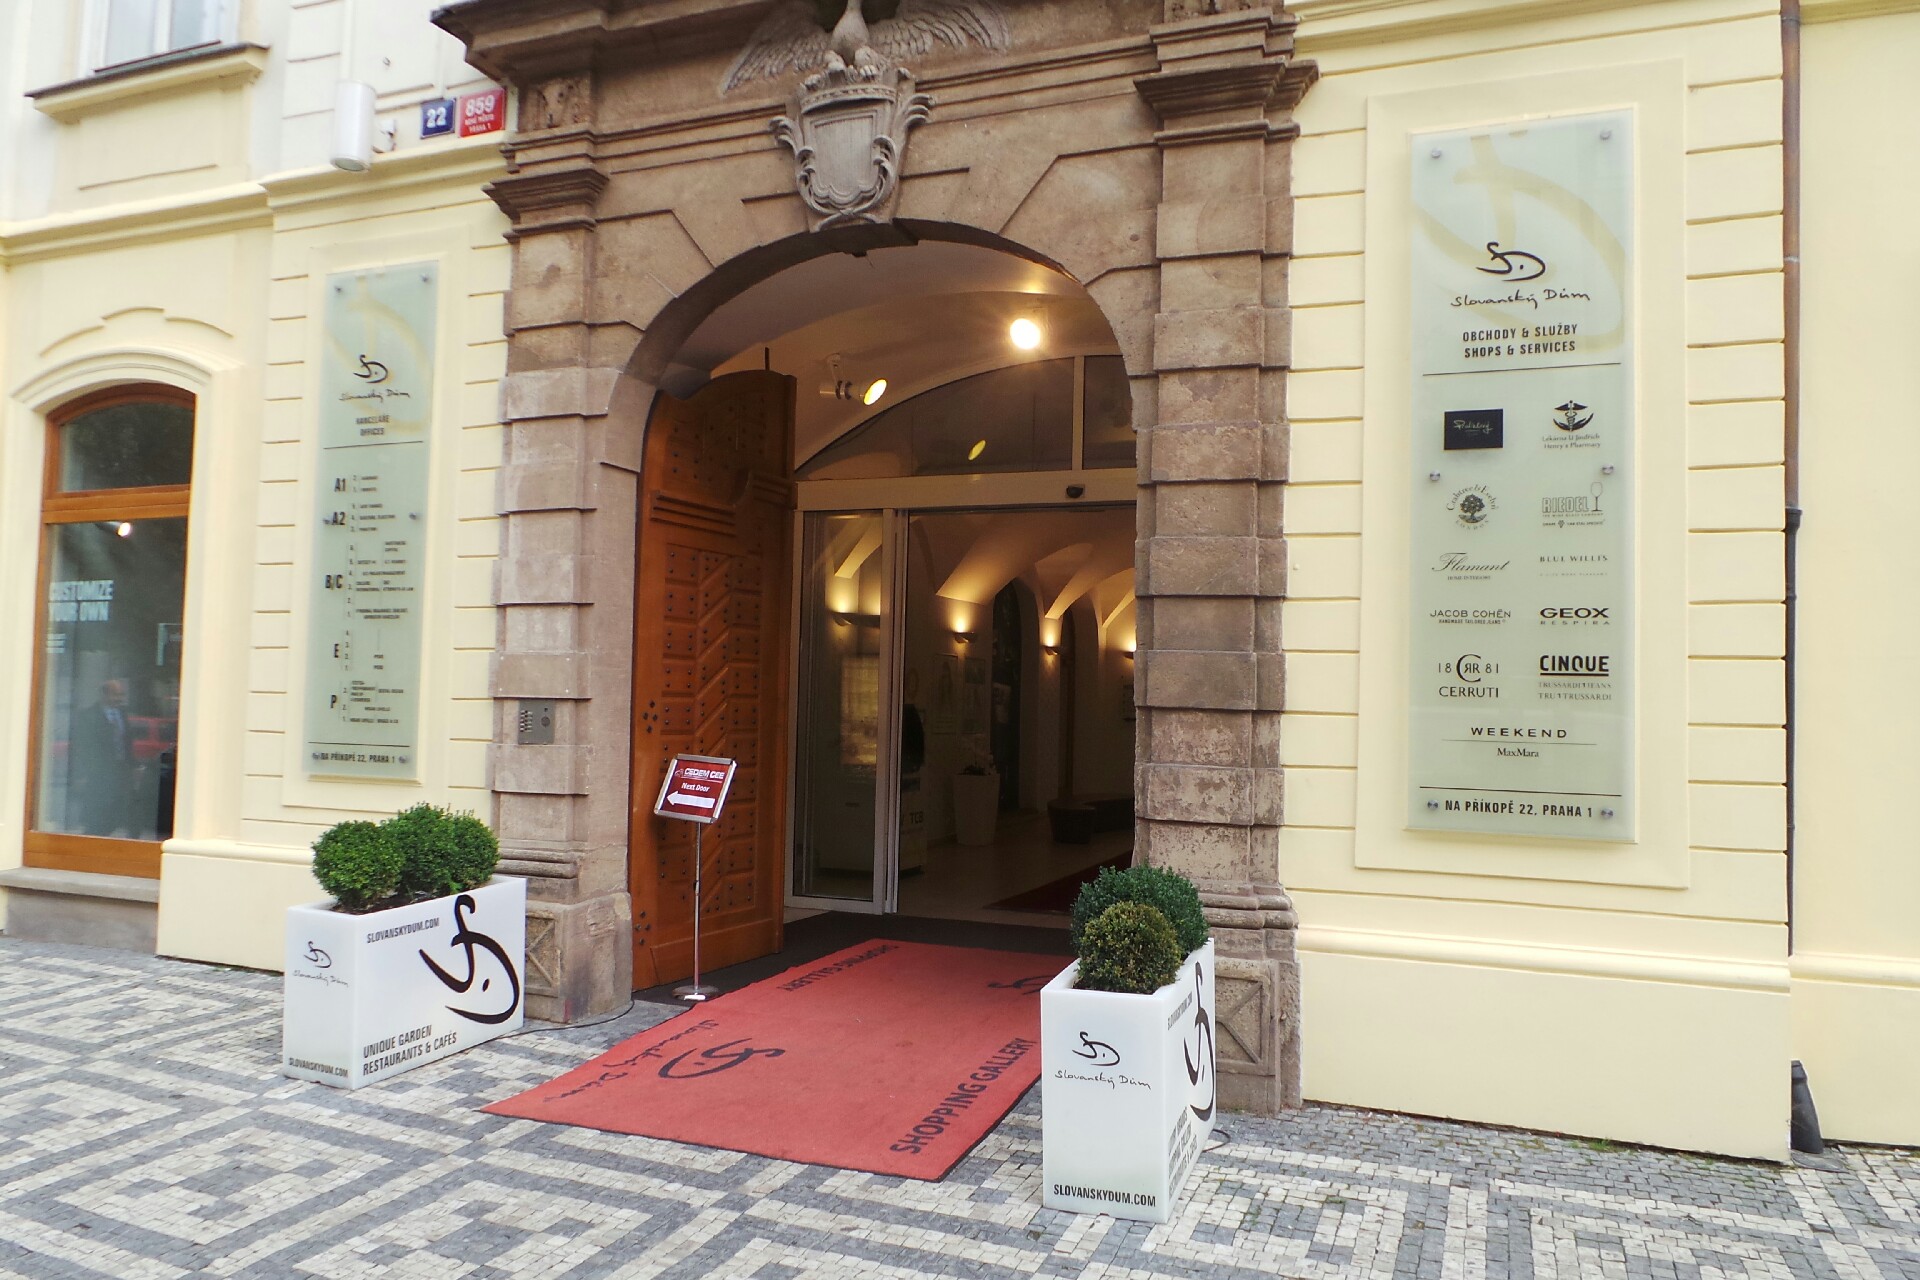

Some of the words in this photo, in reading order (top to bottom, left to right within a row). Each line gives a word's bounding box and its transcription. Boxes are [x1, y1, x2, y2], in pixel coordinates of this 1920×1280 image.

[465, 95, 495, 117] 859
[426, 106, 446, 128] 22
[1450, 289, 1538, 310] Slovanský
[1463, 328, 1516, 342] OBCHODY
[1522, 327, 1529, 338] &
[1535, 322, 1578, 337] SLUŽBY
[1464, 345, 1502, 359] SHOPS
[1507, 345, 1514, 356] &
[1520, 341, 1576, 355] SERVICES
[334, 478, 346, 493] A1
[1542, 496, 1590, 513] RIEDEL
[332, 511, 346, 526] A2
[1432, 552, 1510, 572] Flamant
[1430, 609, 1468, 618] JACOB
[1540, 607, 1610, 619] GEOX
[334, 643, 339, 658] E
[1540, 655, 1610, 672] CINQUE
[1438, 686, 1499, 698] CERRUTI
[1562, 692, 1612, 701] TRUSSARDI
[330, 694, 337, 709] P
[1471, 727, 1567, 738] WEEKEND
[368, 754, 390, 764] PRAHA
[1497, 747, 1540, 758] MaxMara
[681, 782, 695, 791] Next
[695, 784, 711, 792] Door
[1445, 800, 1461, 811] NA
[1465, 799, 1514, 814] PŘÍKOPĚ
[1542, 804, 1582, 817] PRAHA
[1587, 807, 1592, 818] 1
[366, 917, 440, 944] SLOVANSKYDUM.COM
[363, 1036, 396, 1059] UNIQUE
[399, 1024, 432, 1046] GARDEN
[362, 1043, 423, 1076] RESTAURANTS
[425, 1041, 431, 1054] &
[434, 1029, 457, 1051] CAFÉS
[289, 1057, 349, 1078] SLOVANSKYDUM.COM
[889, 1083, 987, 1154] SHOPPING
[970, 1037, 1038, 1082] GALLERY
[1053, 1183, 1156, 1208] SLOVANSKYDUM.COM
